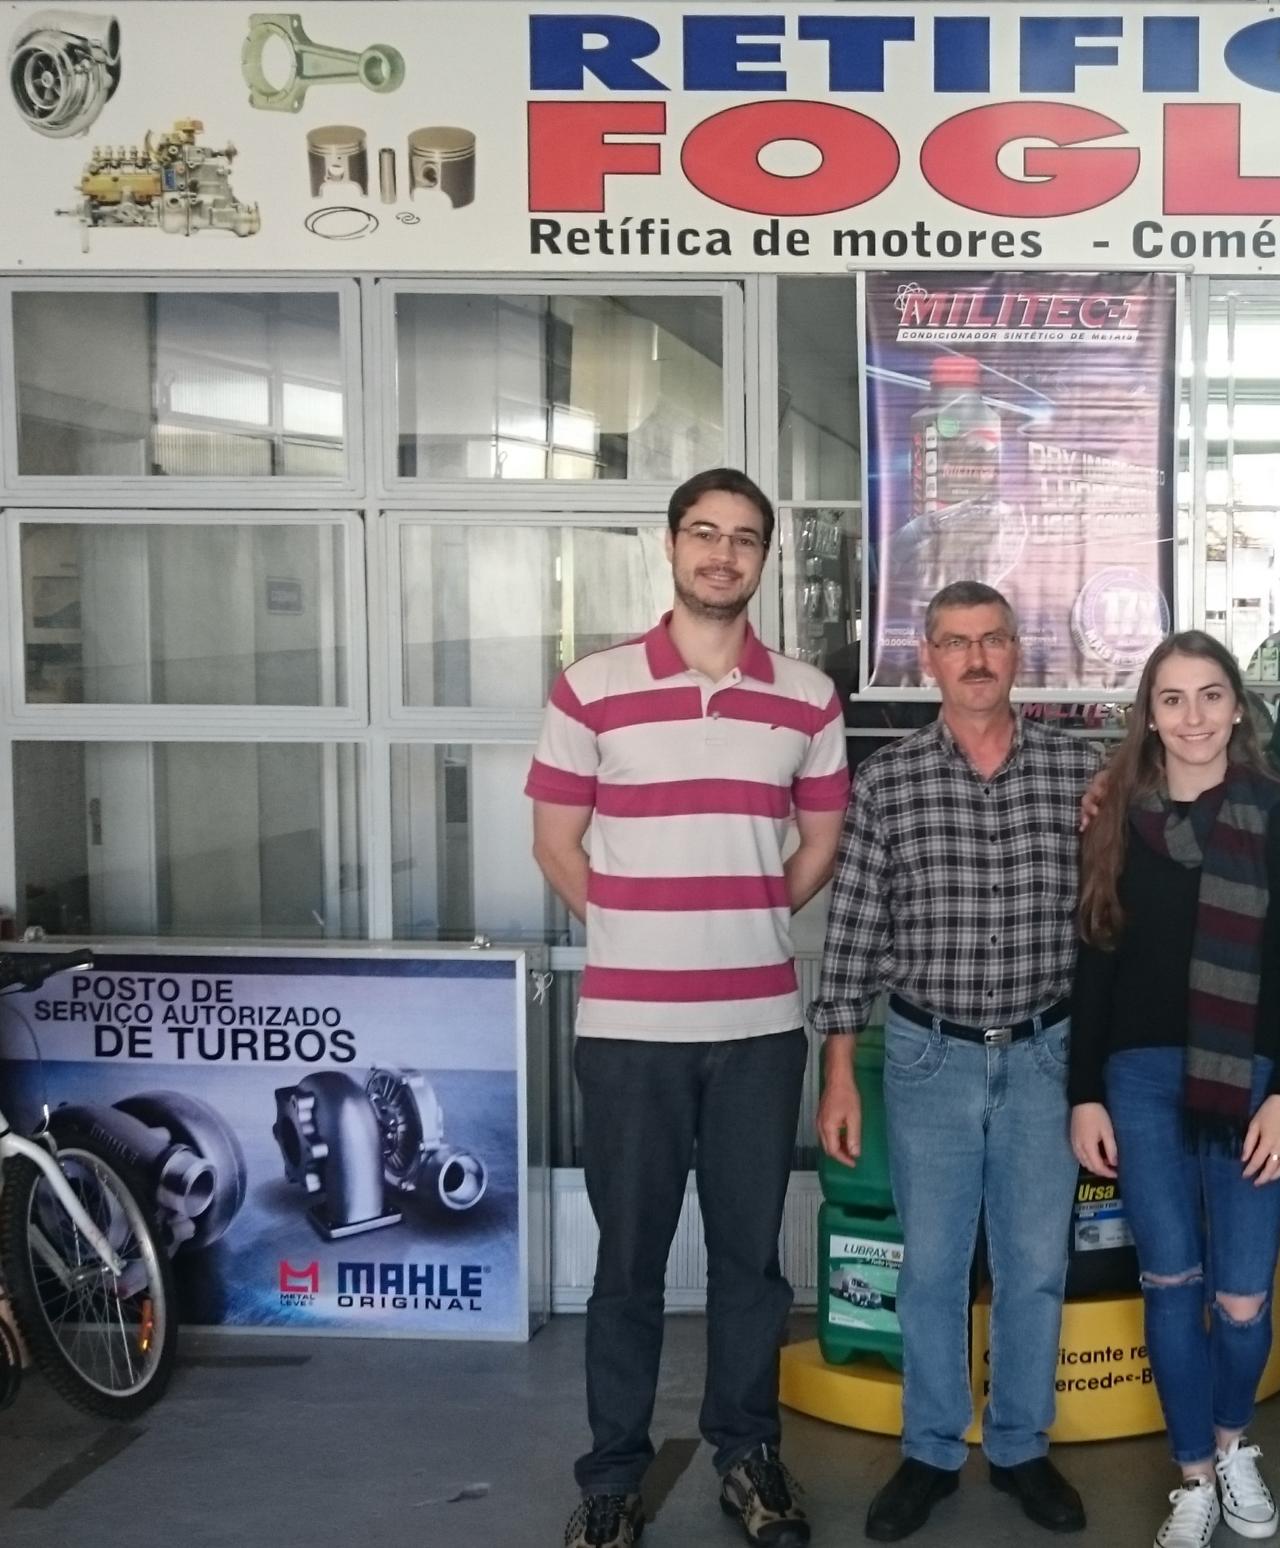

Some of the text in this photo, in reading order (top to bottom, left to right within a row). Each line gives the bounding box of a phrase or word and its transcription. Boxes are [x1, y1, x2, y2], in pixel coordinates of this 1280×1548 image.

[529, 215, 732, 257] Retífica
[752, 218, 811, 258] de
[833, 222, 1043, 259] motores
[899, 292, 1147, 329] MILITEC-1
[901, 331, 998, 341] CONDICIONADOR
[1003, 330, 1064, 341] SINTÉTICO
[1070, 332, 1085, 341] DE
[72, 975, 234, 1002] POSTO DE
[34, 1001, 342, 1028] SERVIÇO AUTORIZADO
[94, 1025, 357, 1064] DE TURBOS
[1078, 1183, 1115, 1202] Ursa
[844, 1242, 889, 1259] LUBRAX
[337, 1262, 482, 1298] MAHLE
[337, 1295, 482, 1311] ORIGINAL
